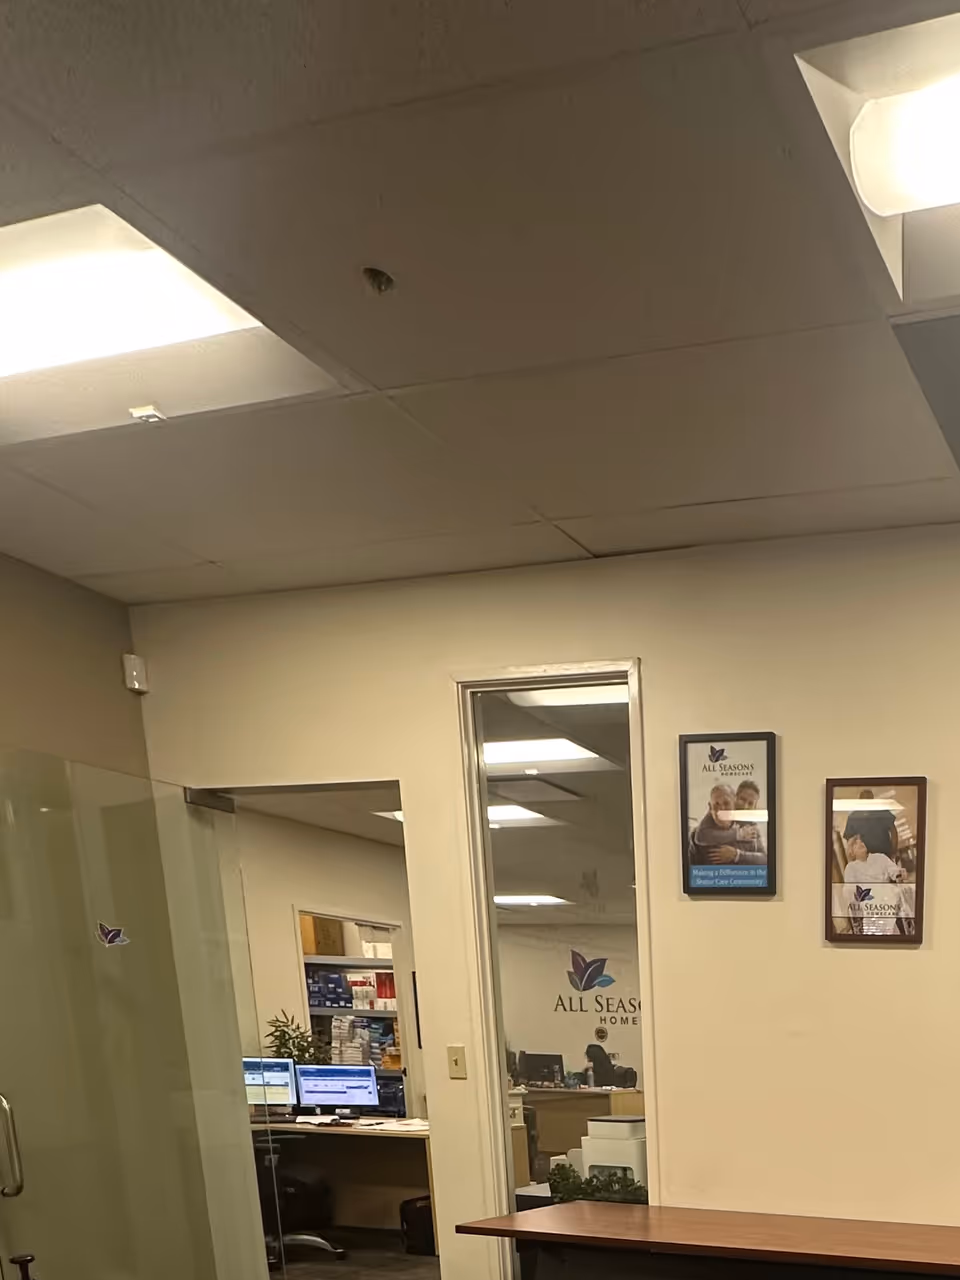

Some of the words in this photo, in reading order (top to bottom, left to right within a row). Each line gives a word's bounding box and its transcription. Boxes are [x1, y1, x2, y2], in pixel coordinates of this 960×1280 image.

[702, 764, 717, 772] ALL
[719, 763, 754, 772] SEASONS
[864, 903, 900, 911] SEASONS
[554, 994, 588, 1012] ALL
